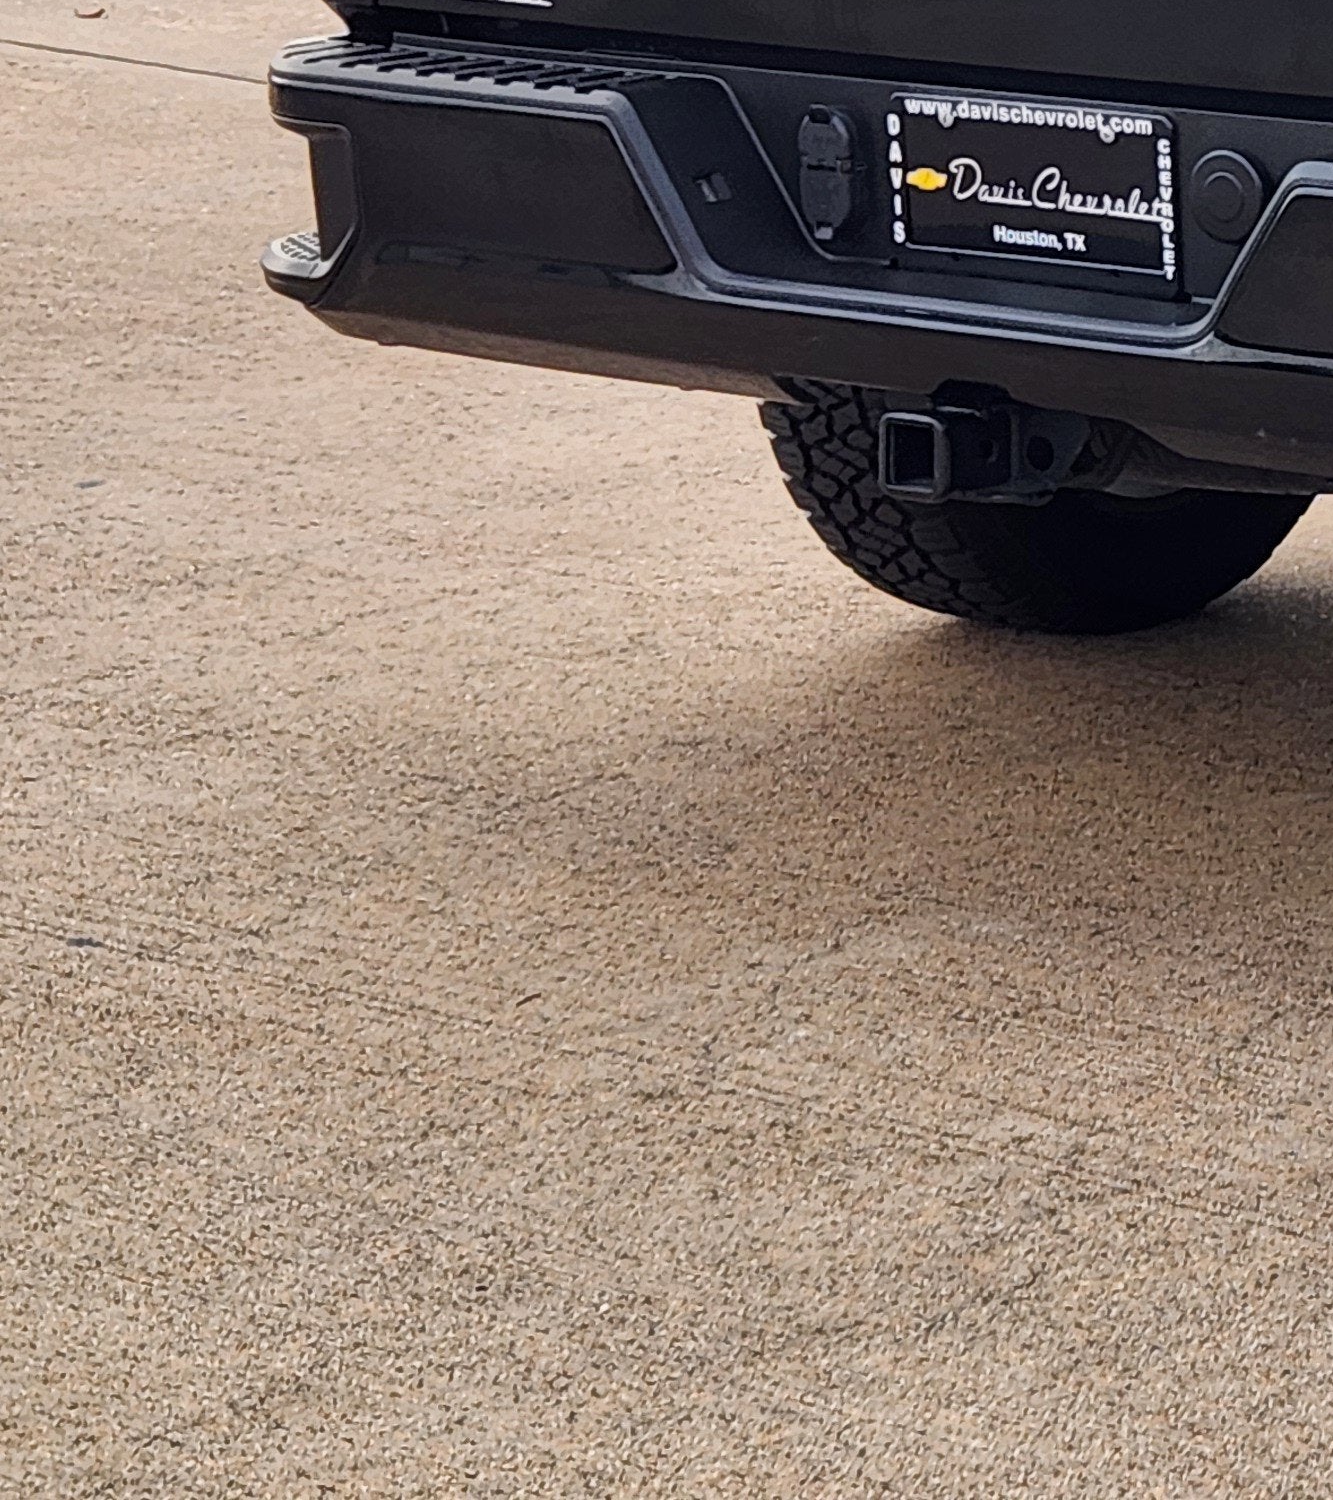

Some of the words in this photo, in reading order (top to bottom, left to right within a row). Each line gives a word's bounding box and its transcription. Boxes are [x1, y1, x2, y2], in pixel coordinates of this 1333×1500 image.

[886, 113, 907, 244] DAVIS
[949, 157, 1032, 207] Davis
[992, 225, 1062, 252] Houston,
[1063, 231, 1087, 252] TX
